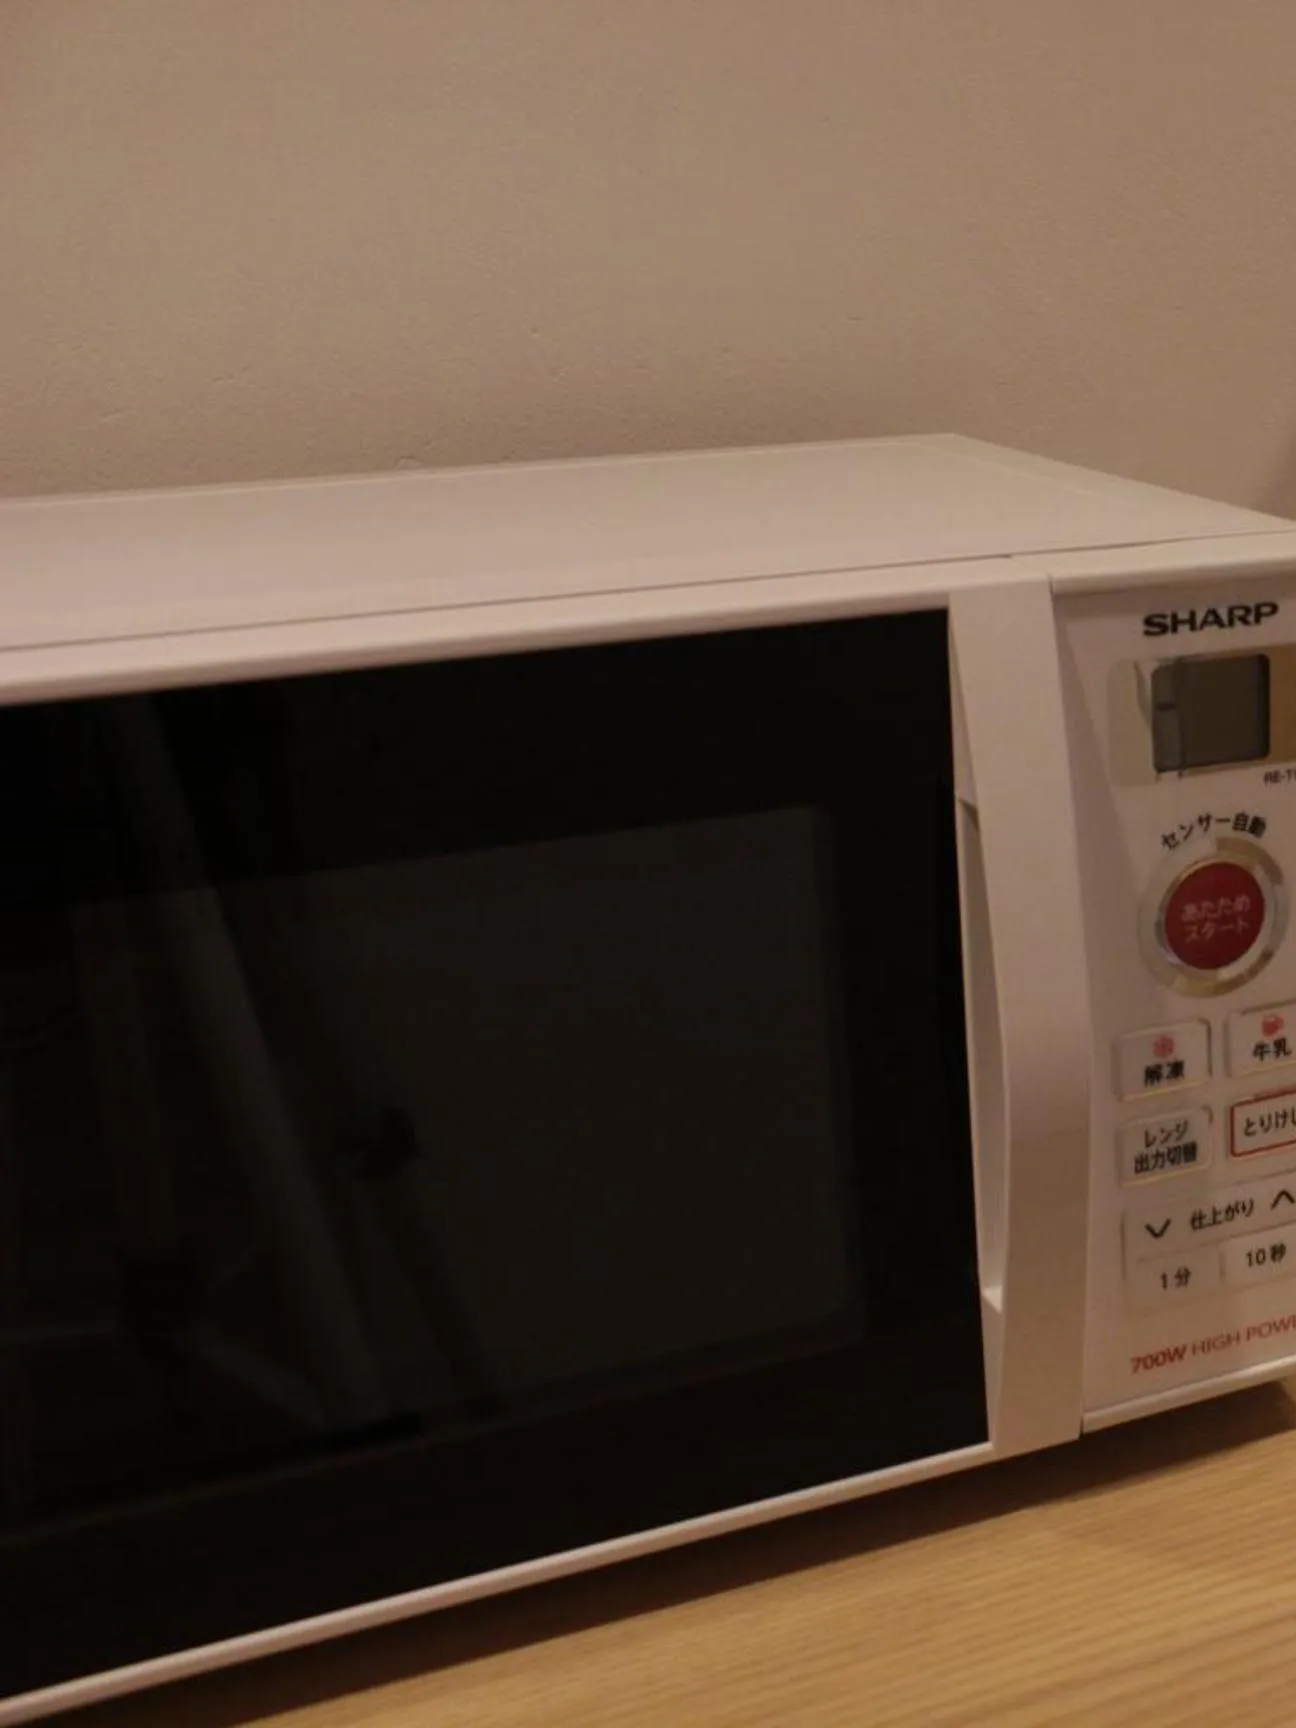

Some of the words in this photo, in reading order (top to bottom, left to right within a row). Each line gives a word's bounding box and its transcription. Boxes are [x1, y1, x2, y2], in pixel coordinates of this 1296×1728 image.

[1142, 602, 1279, 637] SHARP
[1161, 811, 1267, 851] センサー自動
[1184, 915, 1250, 945] スタート
[1252, 1038, 1292, 1062] 牛乳
[1144, 1060, 1184, 1087] 解凍
[1144, 1121, 1188, 1147] レンジ
[1134, 1142, 1198, 1174] 出力切替
[1190, 1198, 1255, 1231] 仕上がり
[1130, 1345, 1188, 1374] 700W
[1191, 1331, 1241, 1357] HIGH
